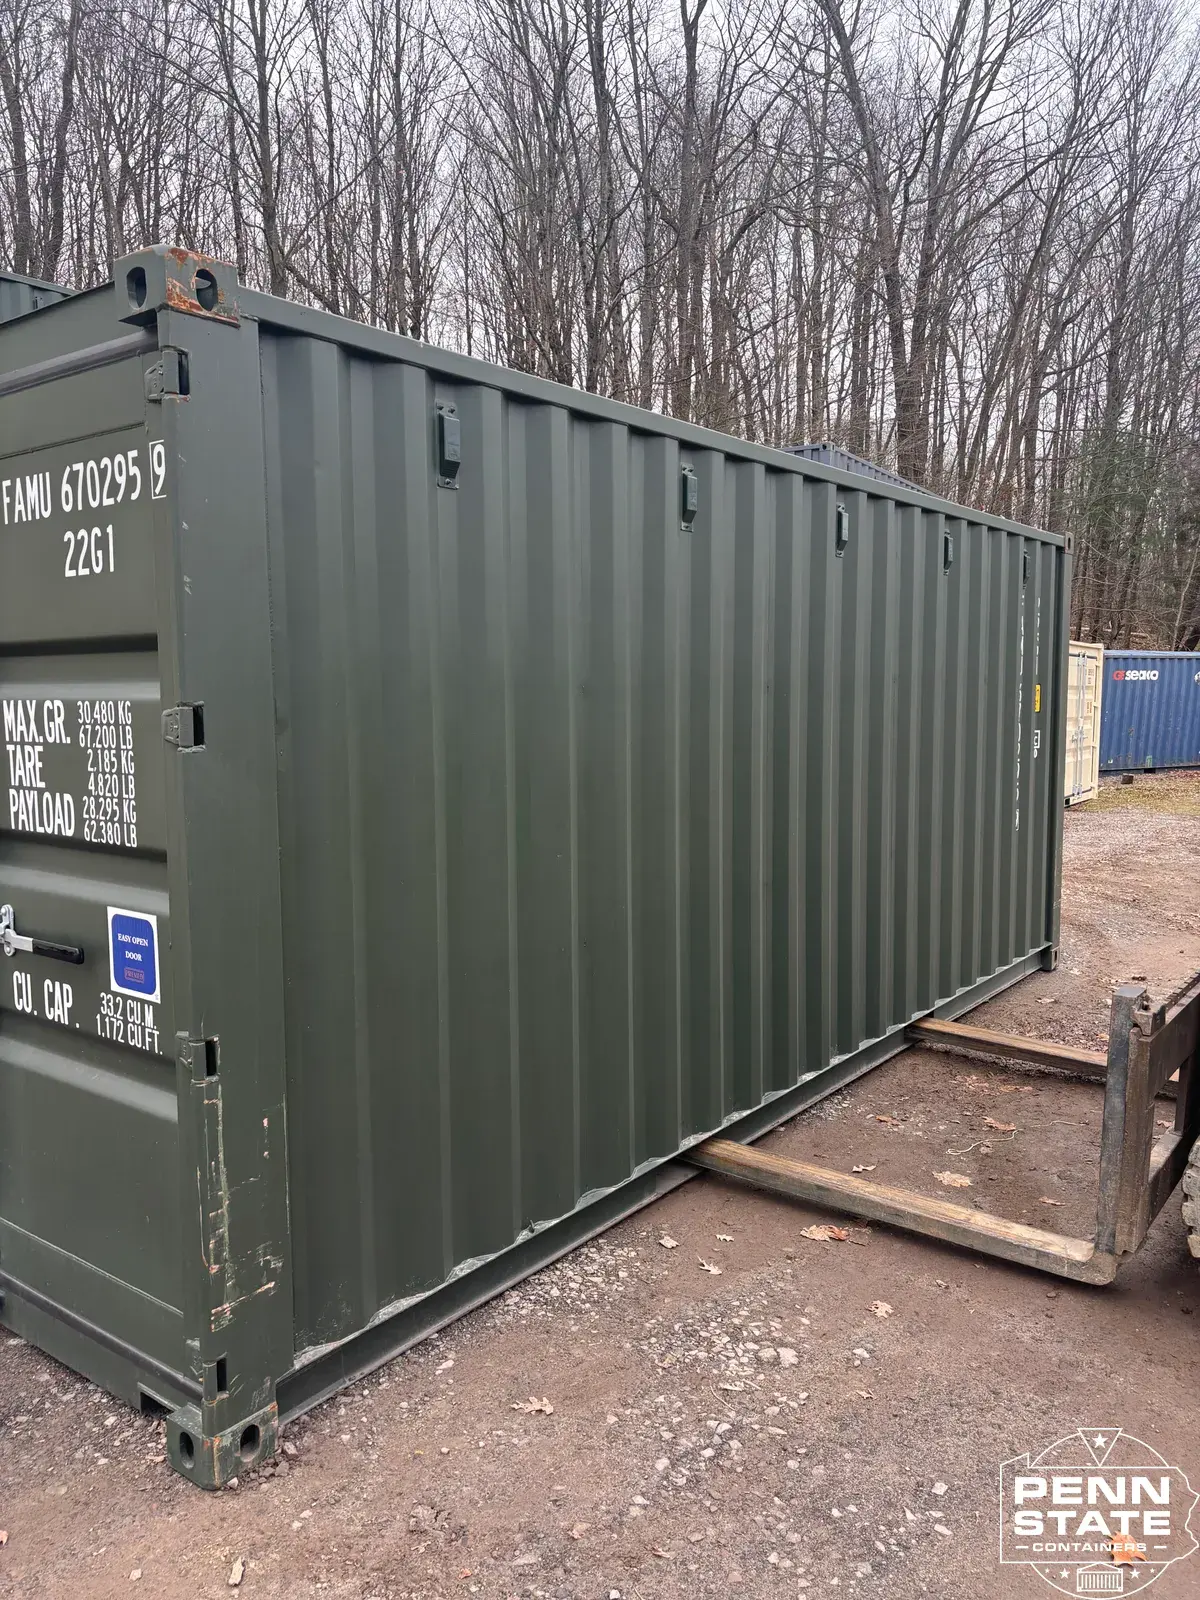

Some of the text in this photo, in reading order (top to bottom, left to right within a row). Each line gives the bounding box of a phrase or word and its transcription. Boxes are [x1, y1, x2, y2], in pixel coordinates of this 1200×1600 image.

[2, 444, 166, 524] FAMU 670295 9
[64, 524, 114, 577] 22G1
[77, 700, 132, 725] 30,480 KG
[79, 725, 133, 749] 67,200 LB
[6, 745, 46, 788] TARE
[87, 749, 135, 774] 2,185 KG
[122, 774, 136, 799] LB
[9, 789, 76, 837] PAYLOAD
[82, 796, 137, 823] 28,295 KG
[123, 823, 138, 848] LB
[117, 933, 149, 947] EASY OPEN
[125, 951, 143, 962] DOOR
[13, 971, 38, 1016] CU.
[100, 992, 124, 1020] 33.2
